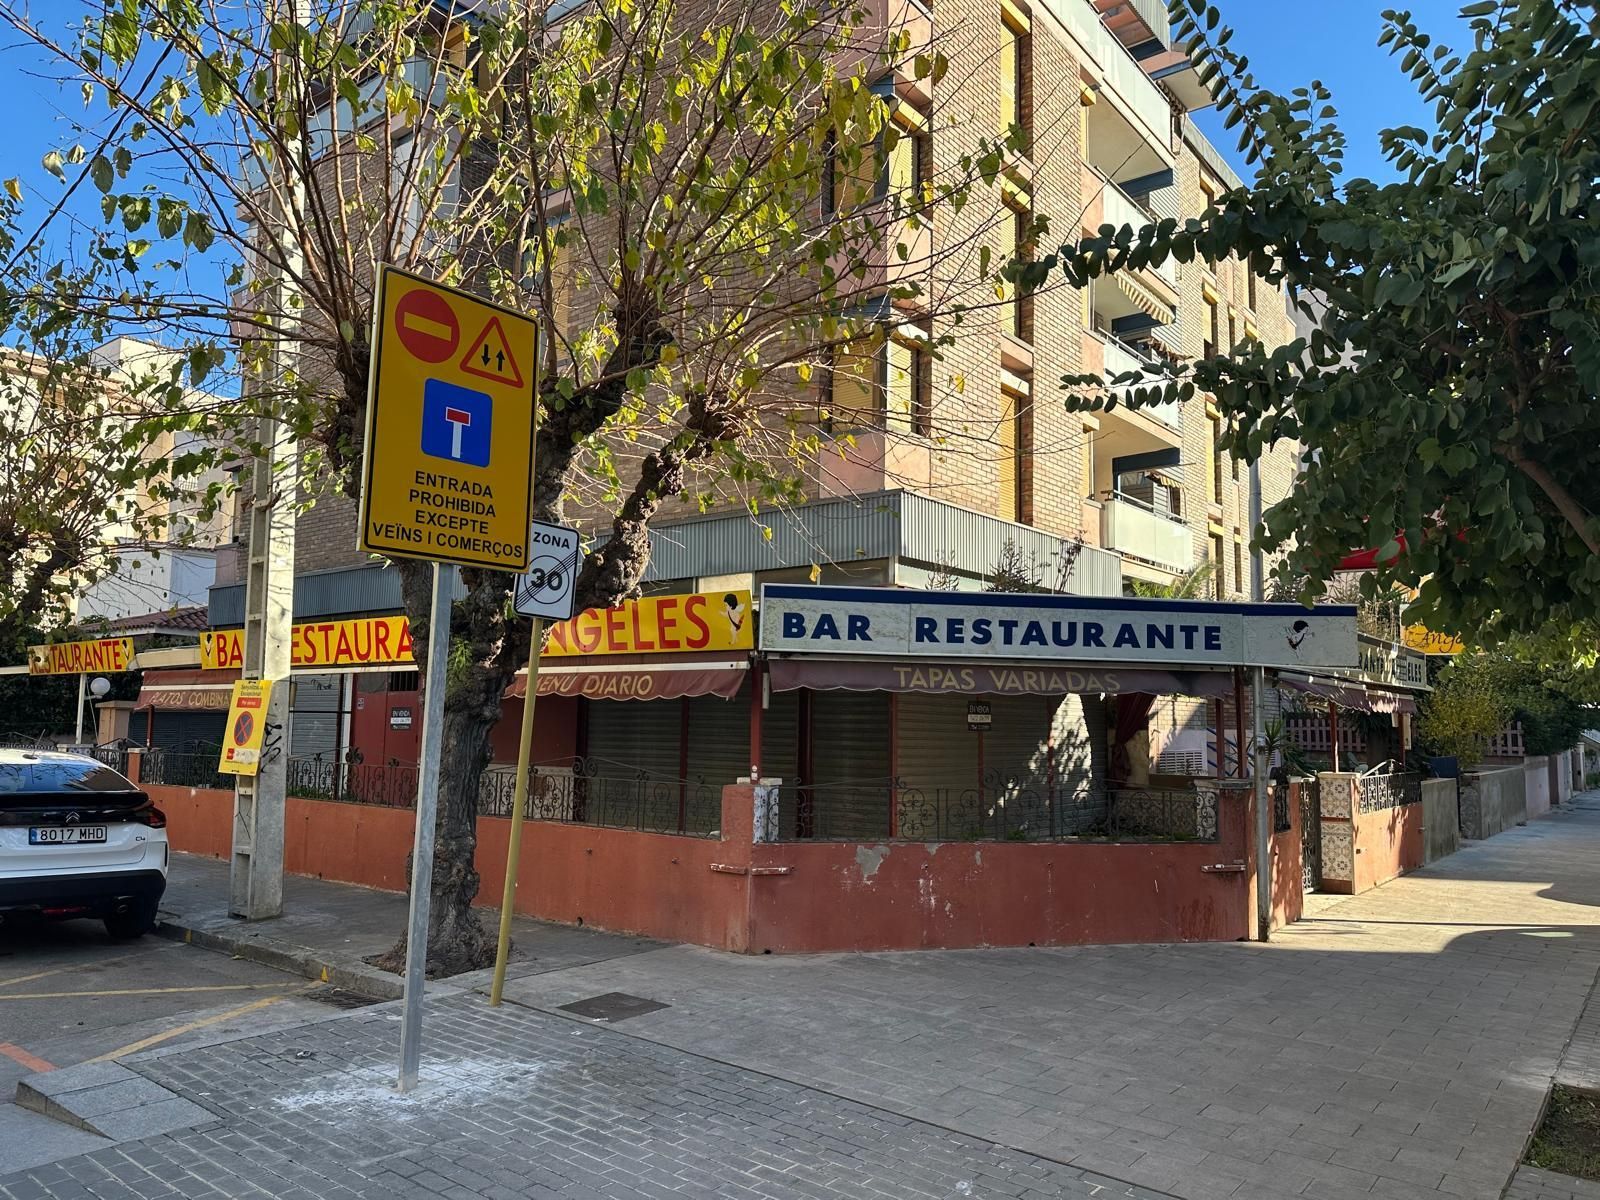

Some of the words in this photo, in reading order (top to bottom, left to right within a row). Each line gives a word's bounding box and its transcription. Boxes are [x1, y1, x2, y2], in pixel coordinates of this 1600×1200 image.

[415, 470, 493, 498] ENTRADA
[409, 489, 496, 517] PROHIBIDA
[415, 509, 489, 534] EXCEPTE
[373, 522, 422, 543] VEÏNS
[427, 531, 432, 544] I
[436, 532, 523, 558] COMERÇOS
[532, 531, 570, 549] ZONA
[531, 567, 563, 591] 30
[543, 595, 710, 653] NGELES
[783, 612, 873, 641] BAR
[915, 616, 1222, 650] RESTAURANTE
[216, 632, 244, 667] BA
[291, 618, 413, 664] ESTAURA
[582, 674, 653, 695] DIARIO
[893, 667, 976, 690] TAPAS
[988, 670, 1121, 692] VARIADAS
[188, 692, 232, 707] COMBINA
[40, 829, 74, 841] 8017
[80, 828, 104, 839] MHD
